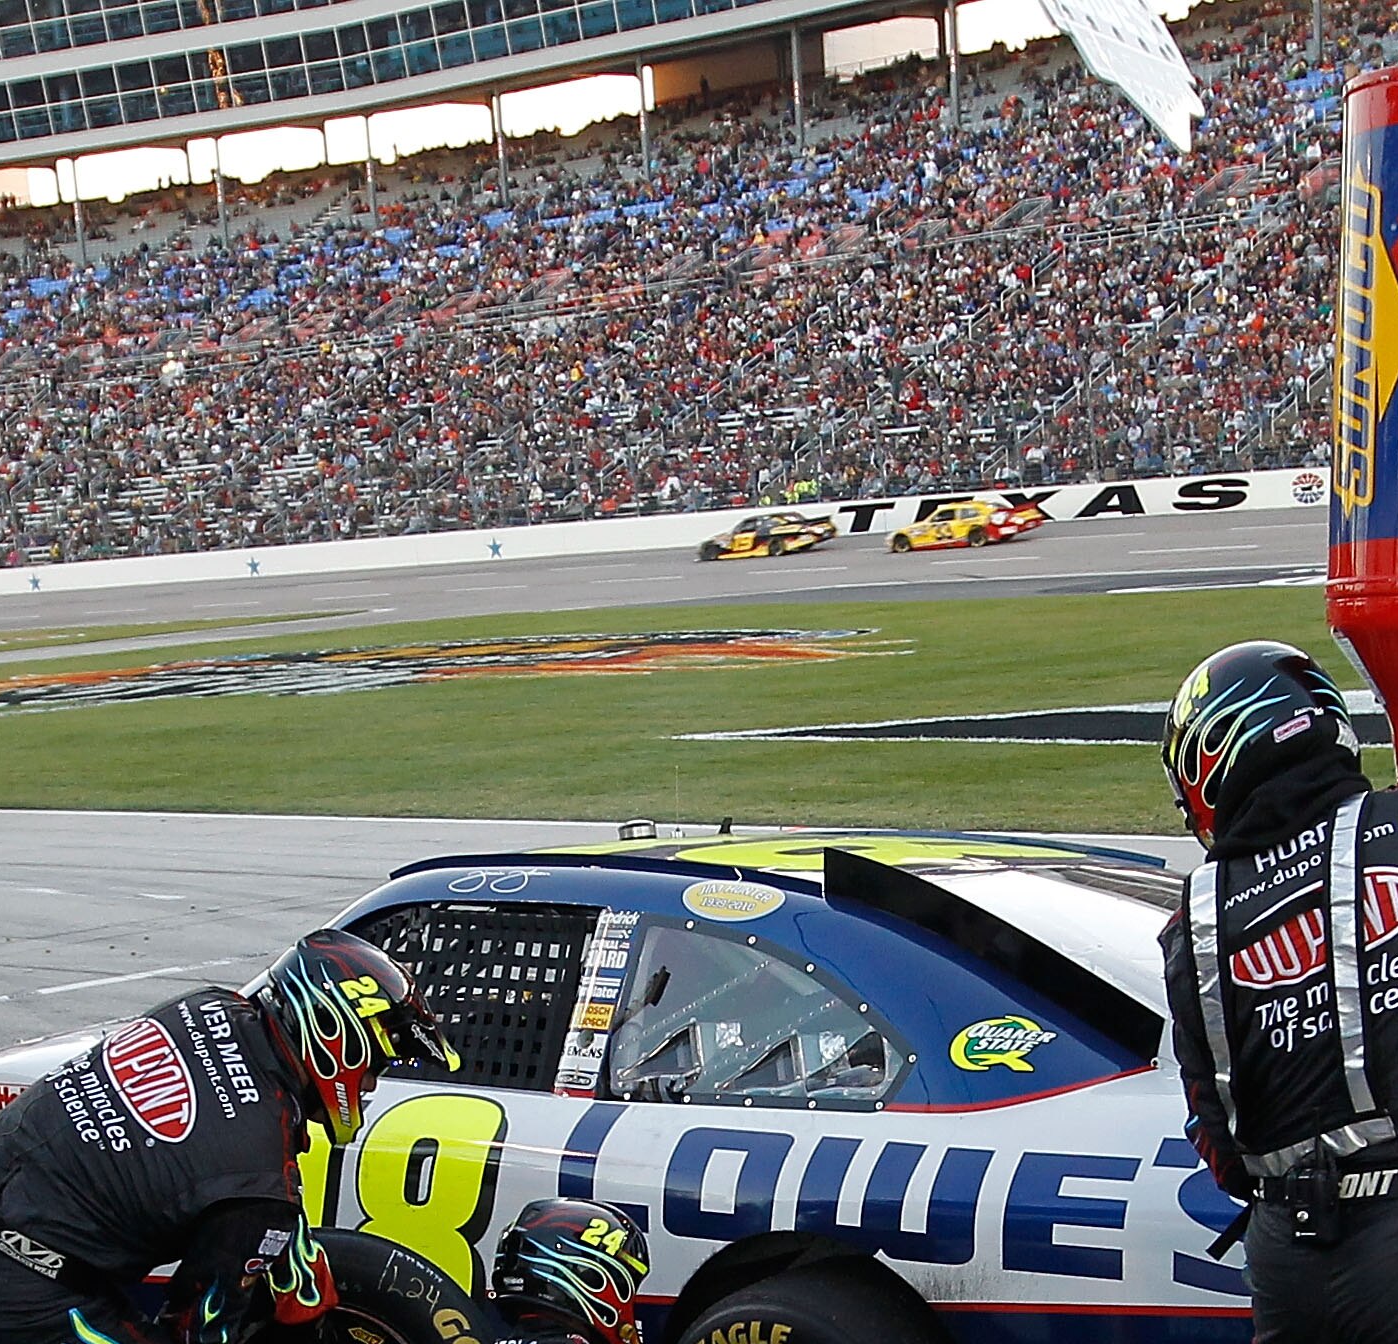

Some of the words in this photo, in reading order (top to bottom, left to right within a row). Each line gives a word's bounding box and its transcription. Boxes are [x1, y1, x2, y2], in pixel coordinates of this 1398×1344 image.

[1172, 665, 1211, 730] 24
[338, 975, 390, 1020] 24
[199, 999, 231, 1041] VER
[219, 1040, 261, 1105] MEER
[967, 1023, 1057, 1043] QUAKER
[973, 1037, 1039, 1053] STATE
[1271, 1016, 1298, 1053] of
[110, 1022, 190, 1129] DUPONT
[55, 1079, 101, 1144] science
[79, 1070, 133, 1153] miracles
[579, 1218, 628, 1256] 24
